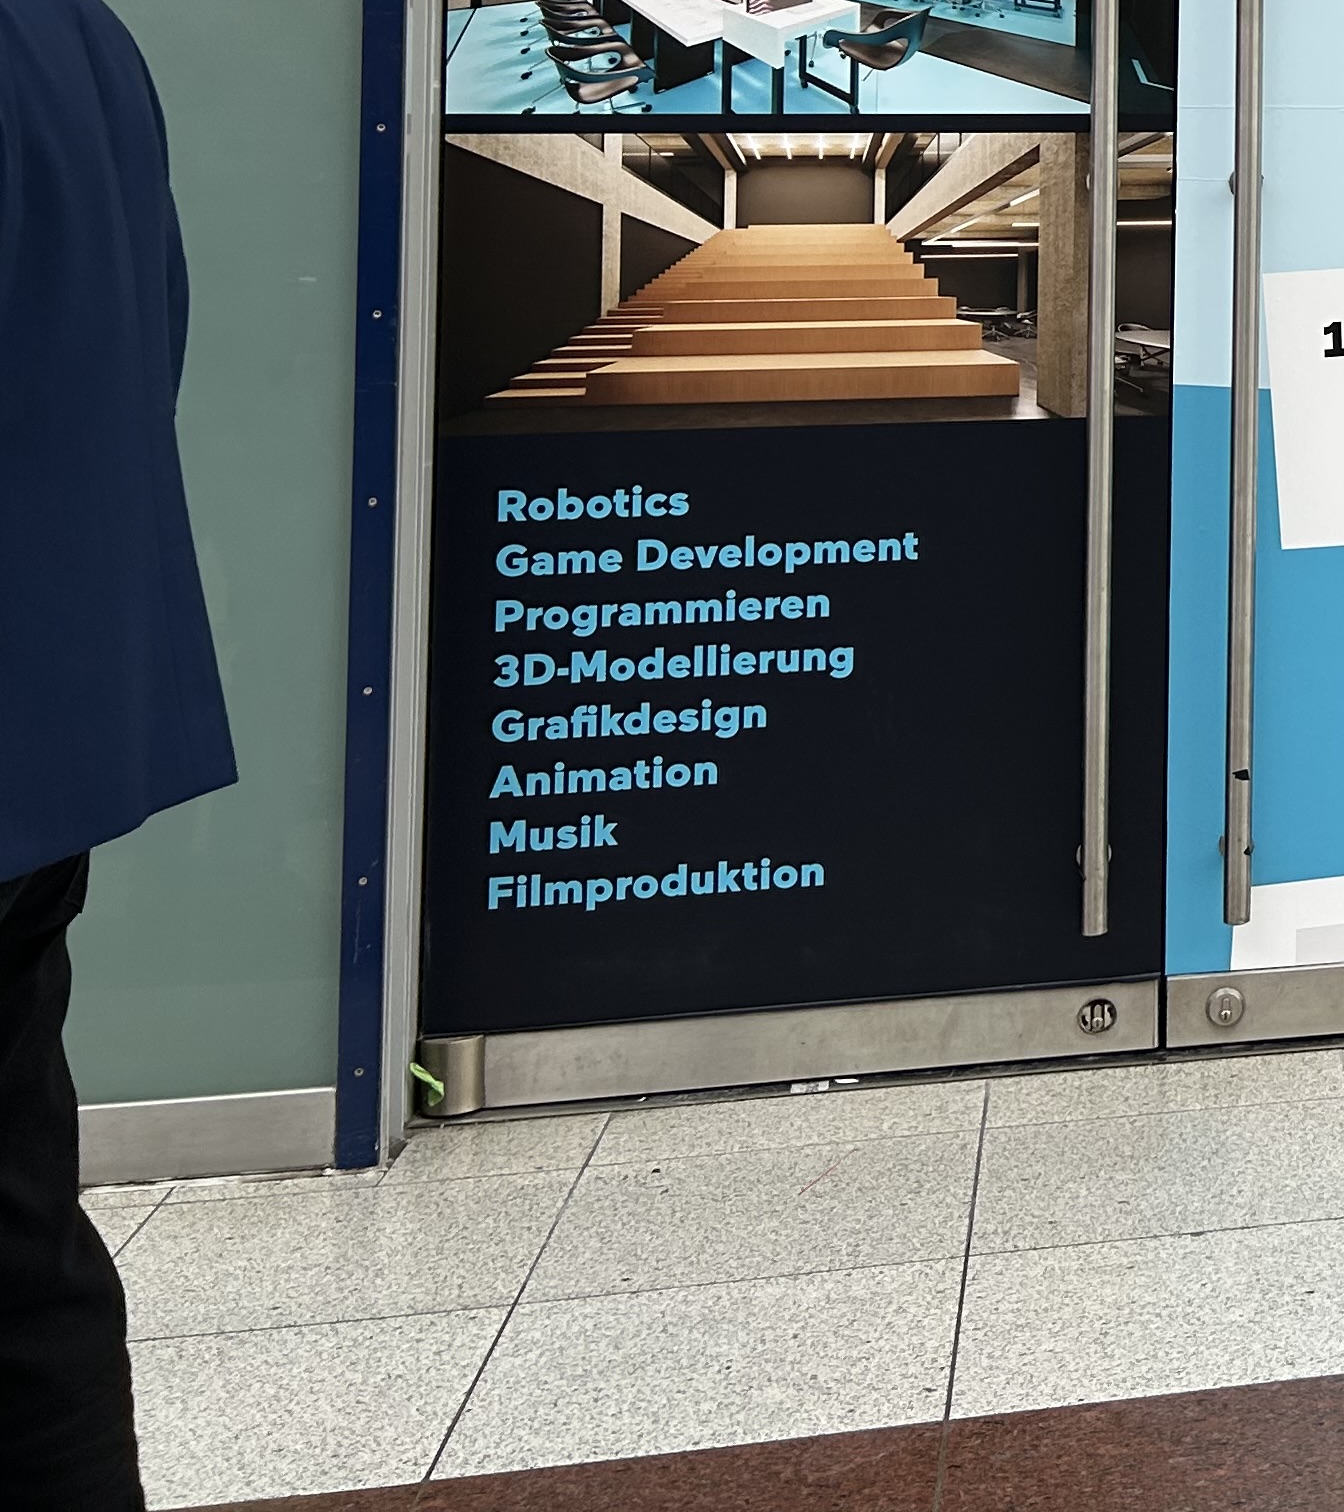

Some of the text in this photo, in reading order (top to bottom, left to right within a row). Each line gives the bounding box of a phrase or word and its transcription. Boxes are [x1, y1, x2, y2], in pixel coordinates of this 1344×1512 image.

[497, 484, 690, 523] Robotics
[495, 532, 919, 578] Game Development
[495, 589, 830, 638] Programmieren
[493, 643, 855, 688] 3D-Modellierung
[491, 698, 767, 743] Grafikdesign
[489, 755, 718, 799] Animation
[489, 814, 619, 855] Musik
[488, 857, 825, 912] Filmproduktion
